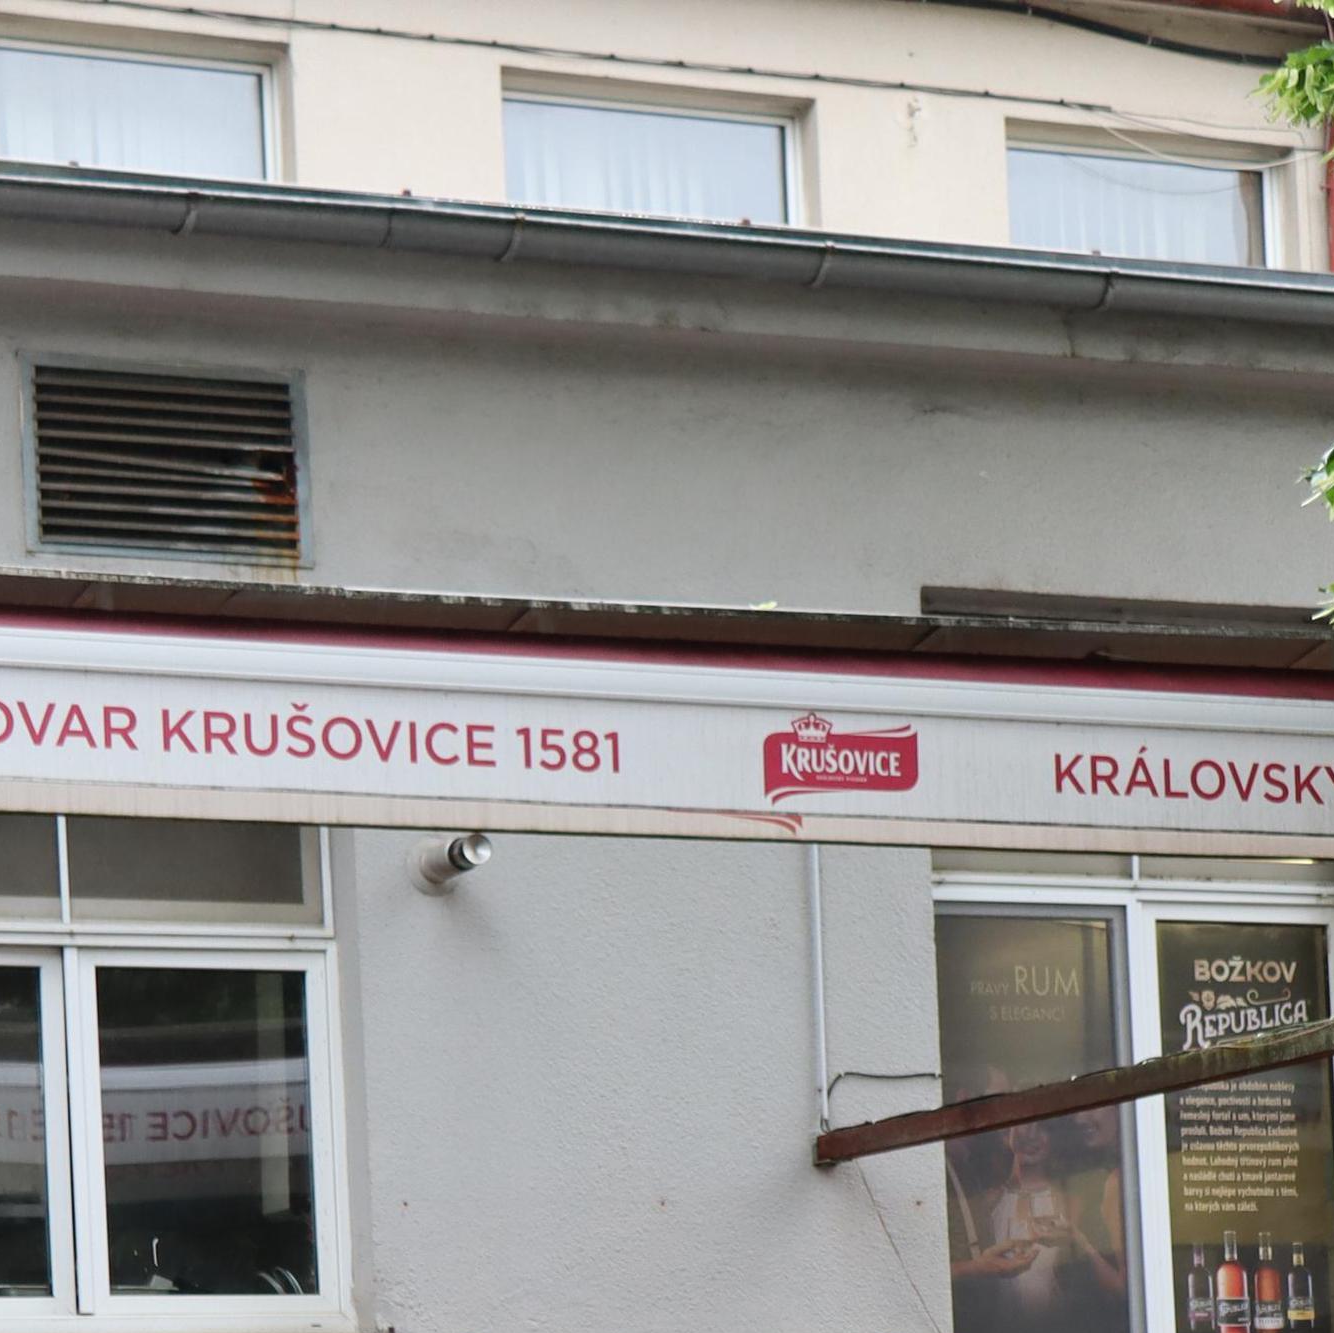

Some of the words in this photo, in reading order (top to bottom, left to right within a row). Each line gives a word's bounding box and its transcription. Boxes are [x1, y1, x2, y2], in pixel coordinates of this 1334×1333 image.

[159, 703, 498, 769] KRUŠOVICE
[516, 725, 621, 774] 1581
[780, 742, 903, 782] KRUŠOVICE
[1014, 965, 1080, 997] RUM
[1193, 955, 1297, 983] BOŽKOV
